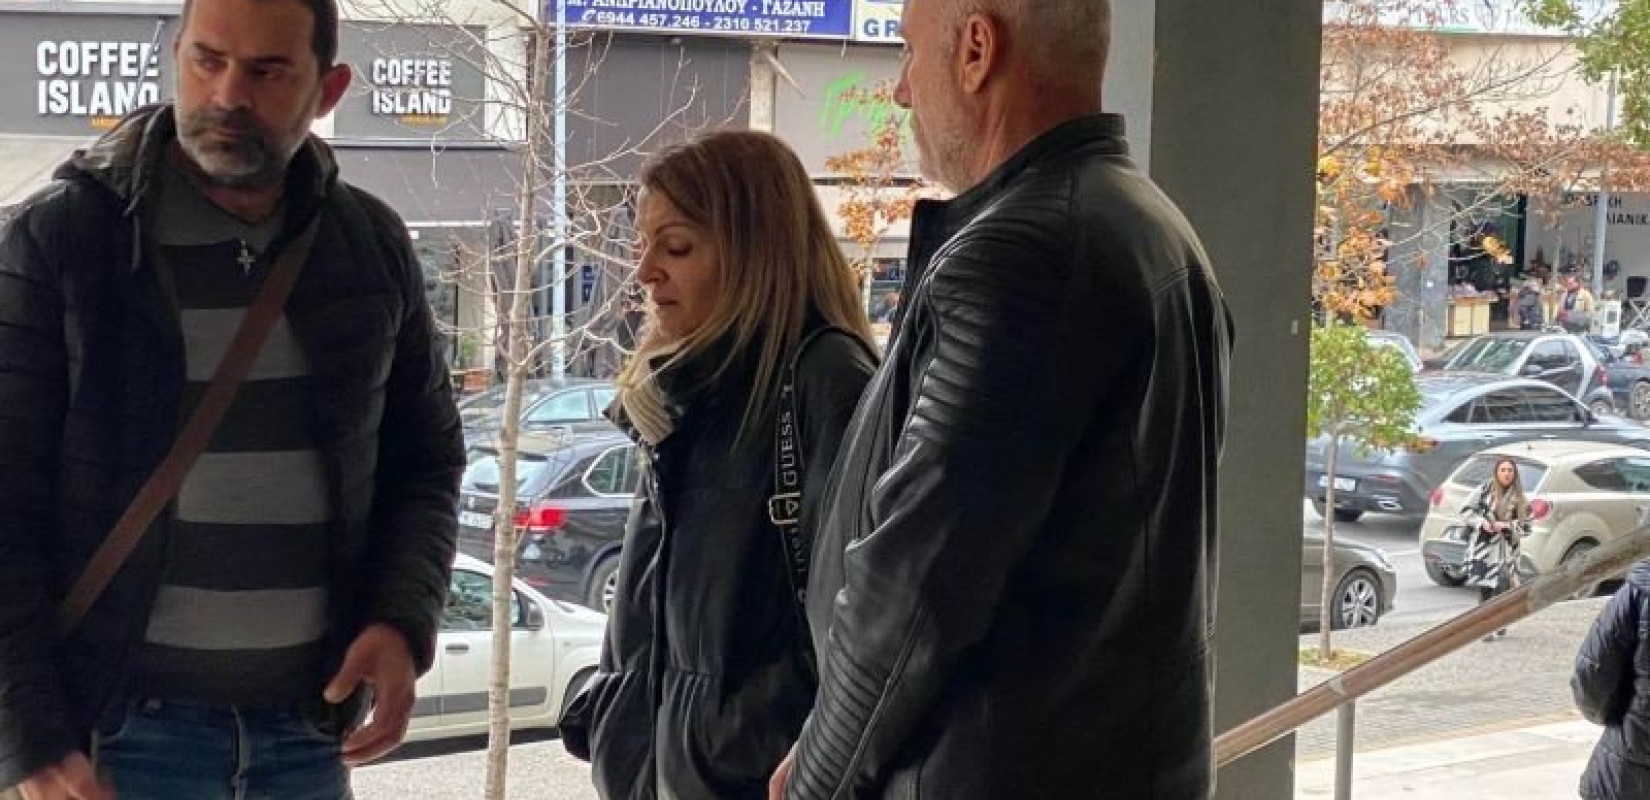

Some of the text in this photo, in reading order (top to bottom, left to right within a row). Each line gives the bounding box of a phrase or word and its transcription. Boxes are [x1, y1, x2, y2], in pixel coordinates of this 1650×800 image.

[761, 0, 825, 17] ΓΑΖΑΝΗ
[713, 16, 749, 29] 2310
[37, 41, 158, 76] COFFEE
[373, 58, 452, 85] COFFEE
[38, 80, 158, 115] ISLAND
[373, 88, 451, 114] ISLAND
[781, 411, 797, 486] GUESS
